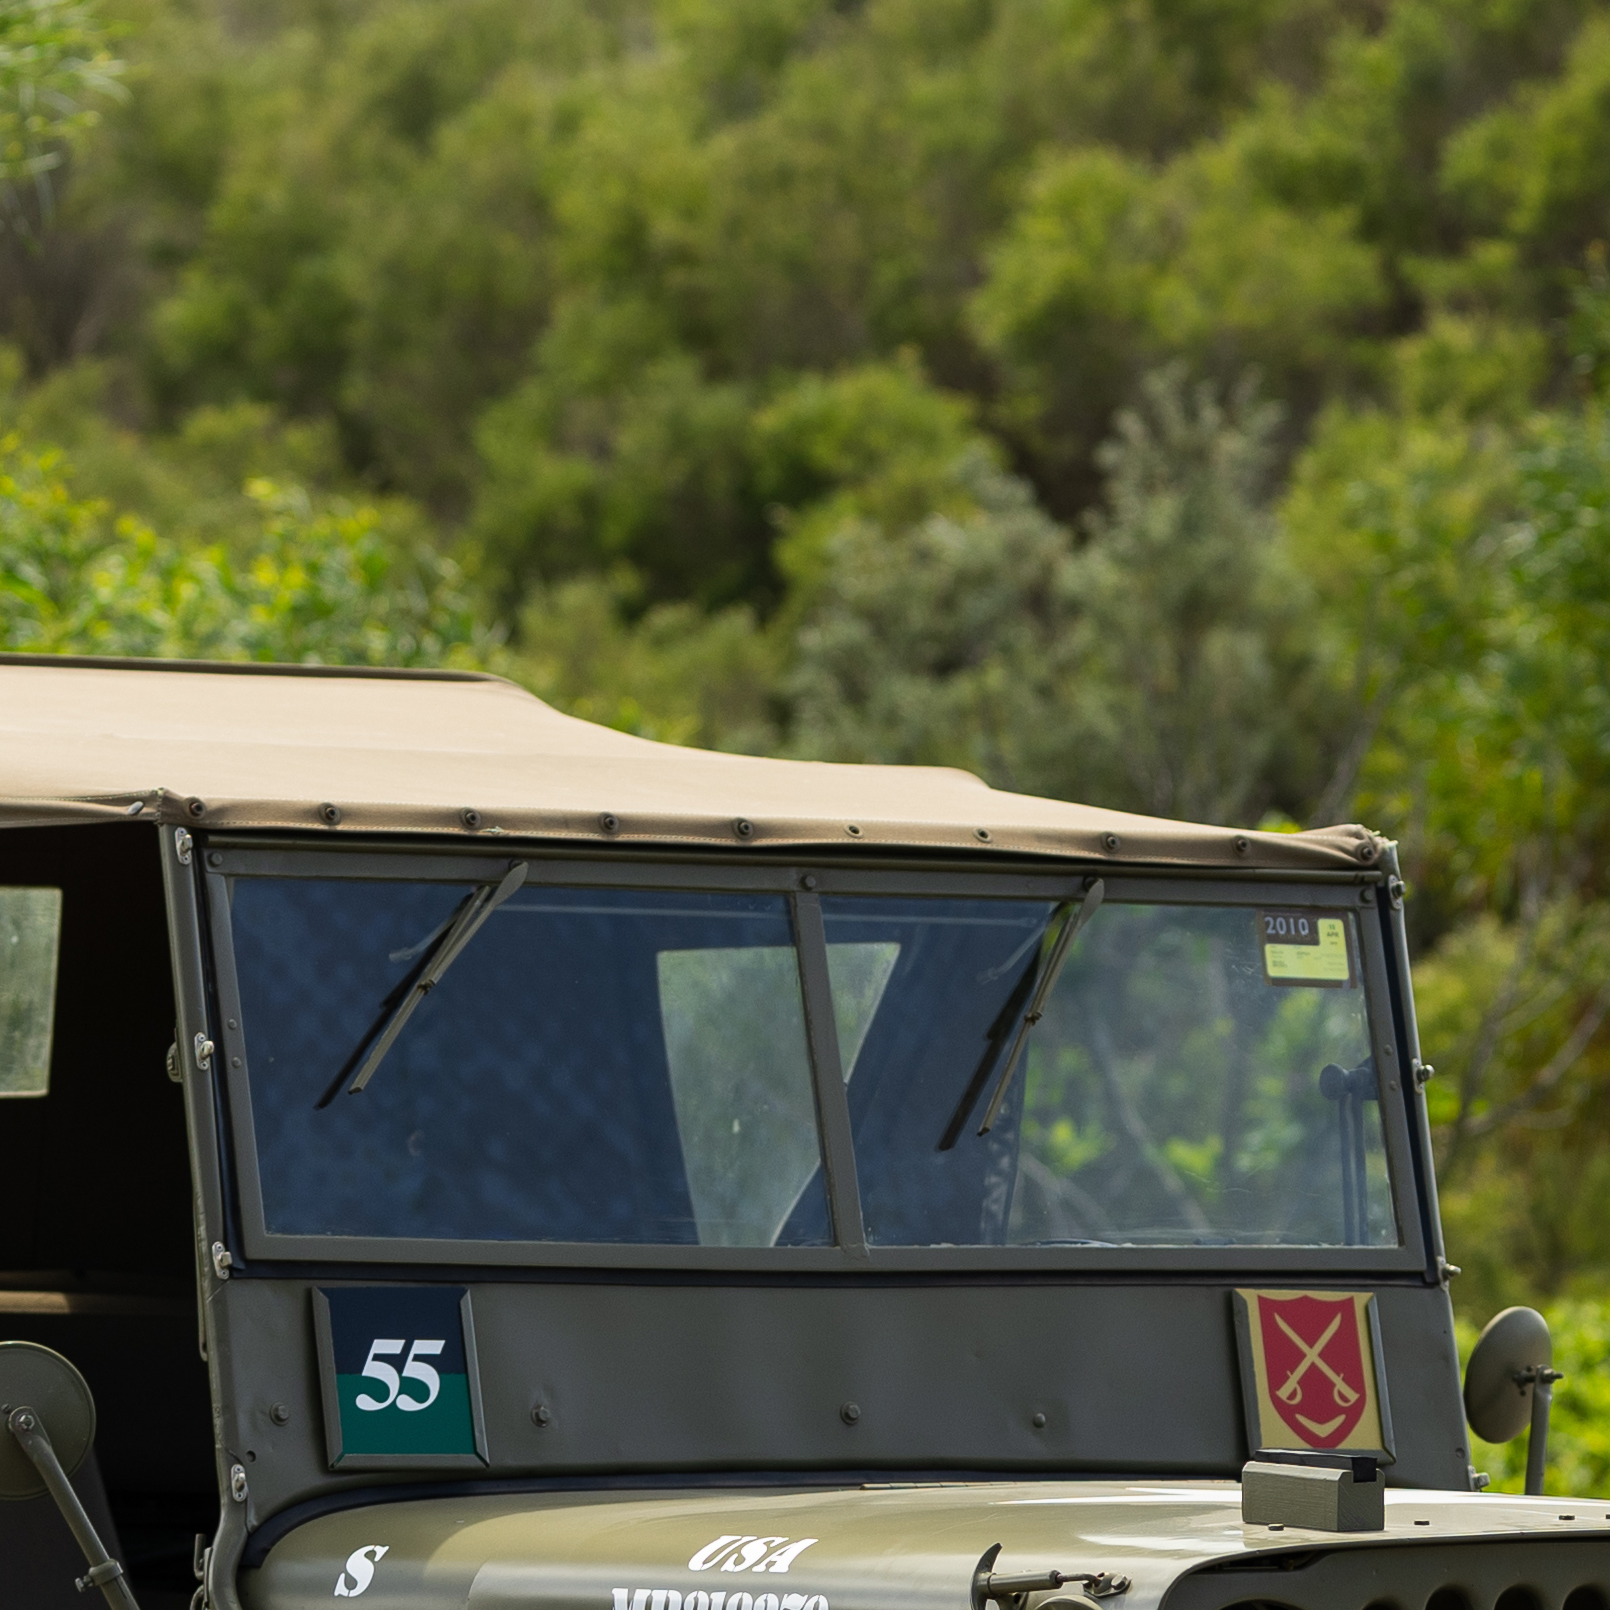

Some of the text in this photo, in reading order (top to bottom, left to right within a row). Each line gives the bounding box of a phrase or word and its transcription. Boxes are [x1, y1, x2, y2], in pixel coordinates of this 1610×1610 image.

[1264, 917, 1310, 936] 2010
[355, 1338, 446, 1412] 55
[333, 1544, 389, 1598] S
[688, 1535, 819, 1573] USA
